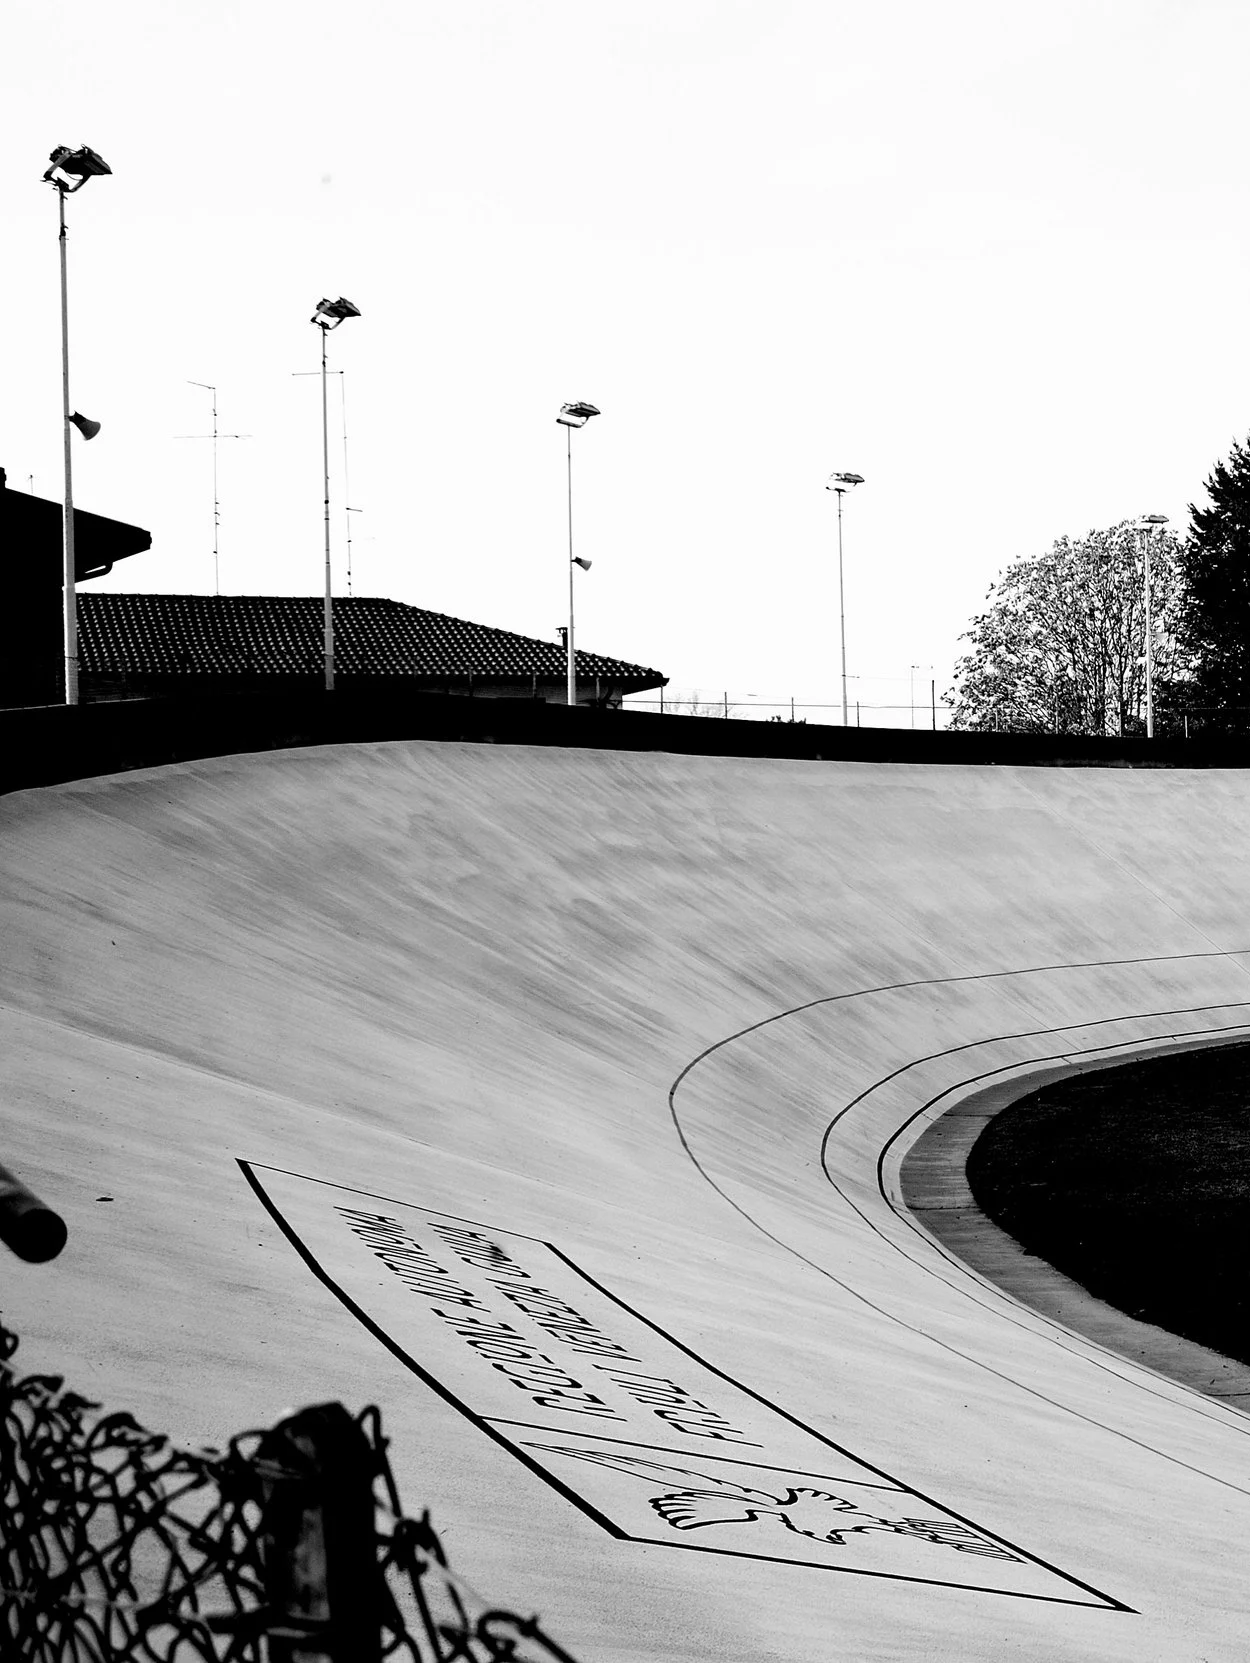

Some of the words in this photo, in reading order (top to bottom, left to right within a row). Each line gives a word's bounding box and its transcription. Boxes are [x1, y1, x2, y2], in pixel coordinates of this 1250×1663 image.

[334, 1207, 490, 1312] AUTONOMA
[431, 1308, 627, 1421] REGIONE
[486, 1278, 641, 1362] VENEZIA
[592, 1364, 763, 1447] FRIULI
